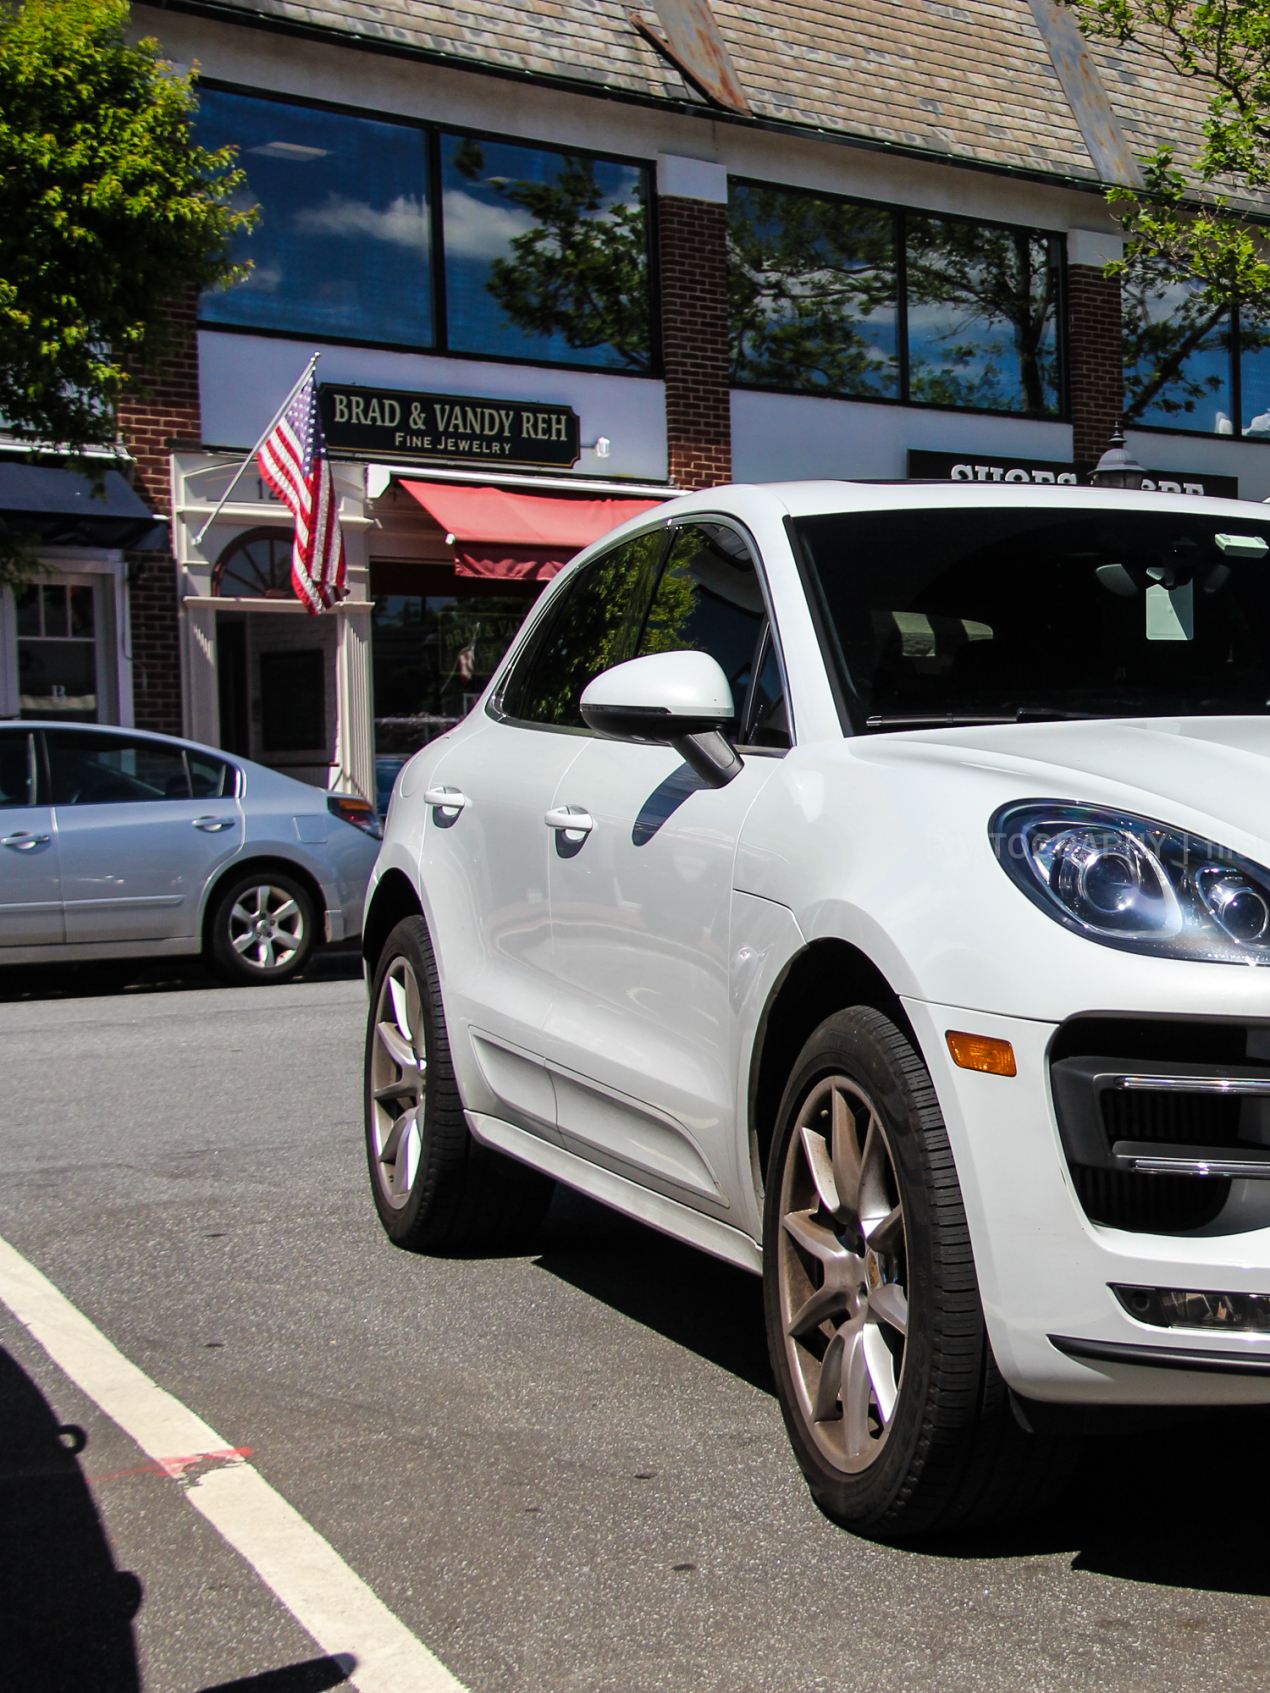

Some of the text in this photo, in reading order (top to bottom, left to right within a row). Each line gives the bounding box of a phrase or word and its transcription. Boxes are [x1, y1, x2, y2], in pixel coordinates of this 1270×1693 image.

[333, 394, 568, 441] BRAD & VANDY REH
[395, 432, 512, 455] FINE JEWELRY
